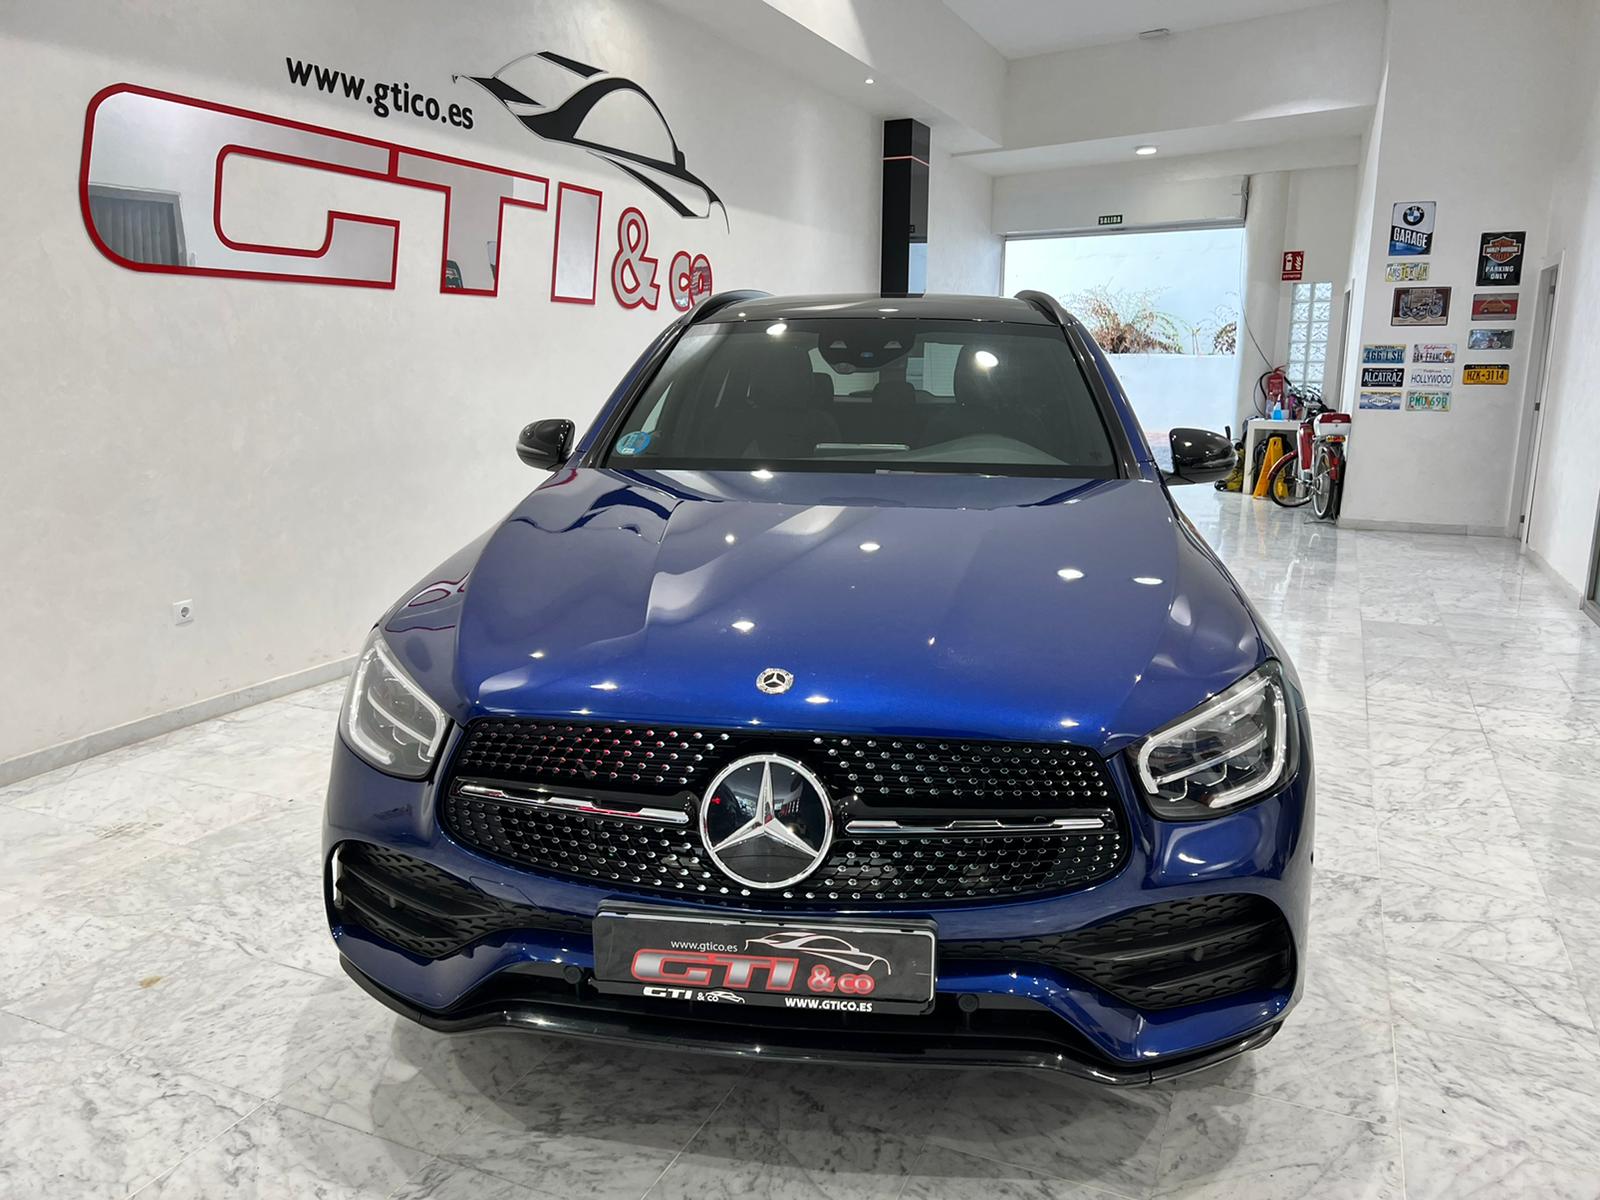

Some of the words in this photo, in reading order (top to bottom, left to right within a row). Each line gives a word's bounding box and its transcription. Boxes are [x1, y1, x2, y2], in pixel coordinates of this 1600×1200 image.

[286, 57, 474, 130] www.gtico.es
[79, 83, 603, 304] GTI
[611, 207, 660, 310] &
[1393, 227, 1428, 248] GARAGE
[1363, 371, 1402, 383] ALCATRAZ
[1410, 374, 1451, 384] HOLLYWOOD
[670, 940, 738, 953] www.gtico.es
[631, 948, 799, 991] GTI
[643, 986, 693, 1000] GTI
[785, 997, 873, 1013] WWW.GTICO.ES
